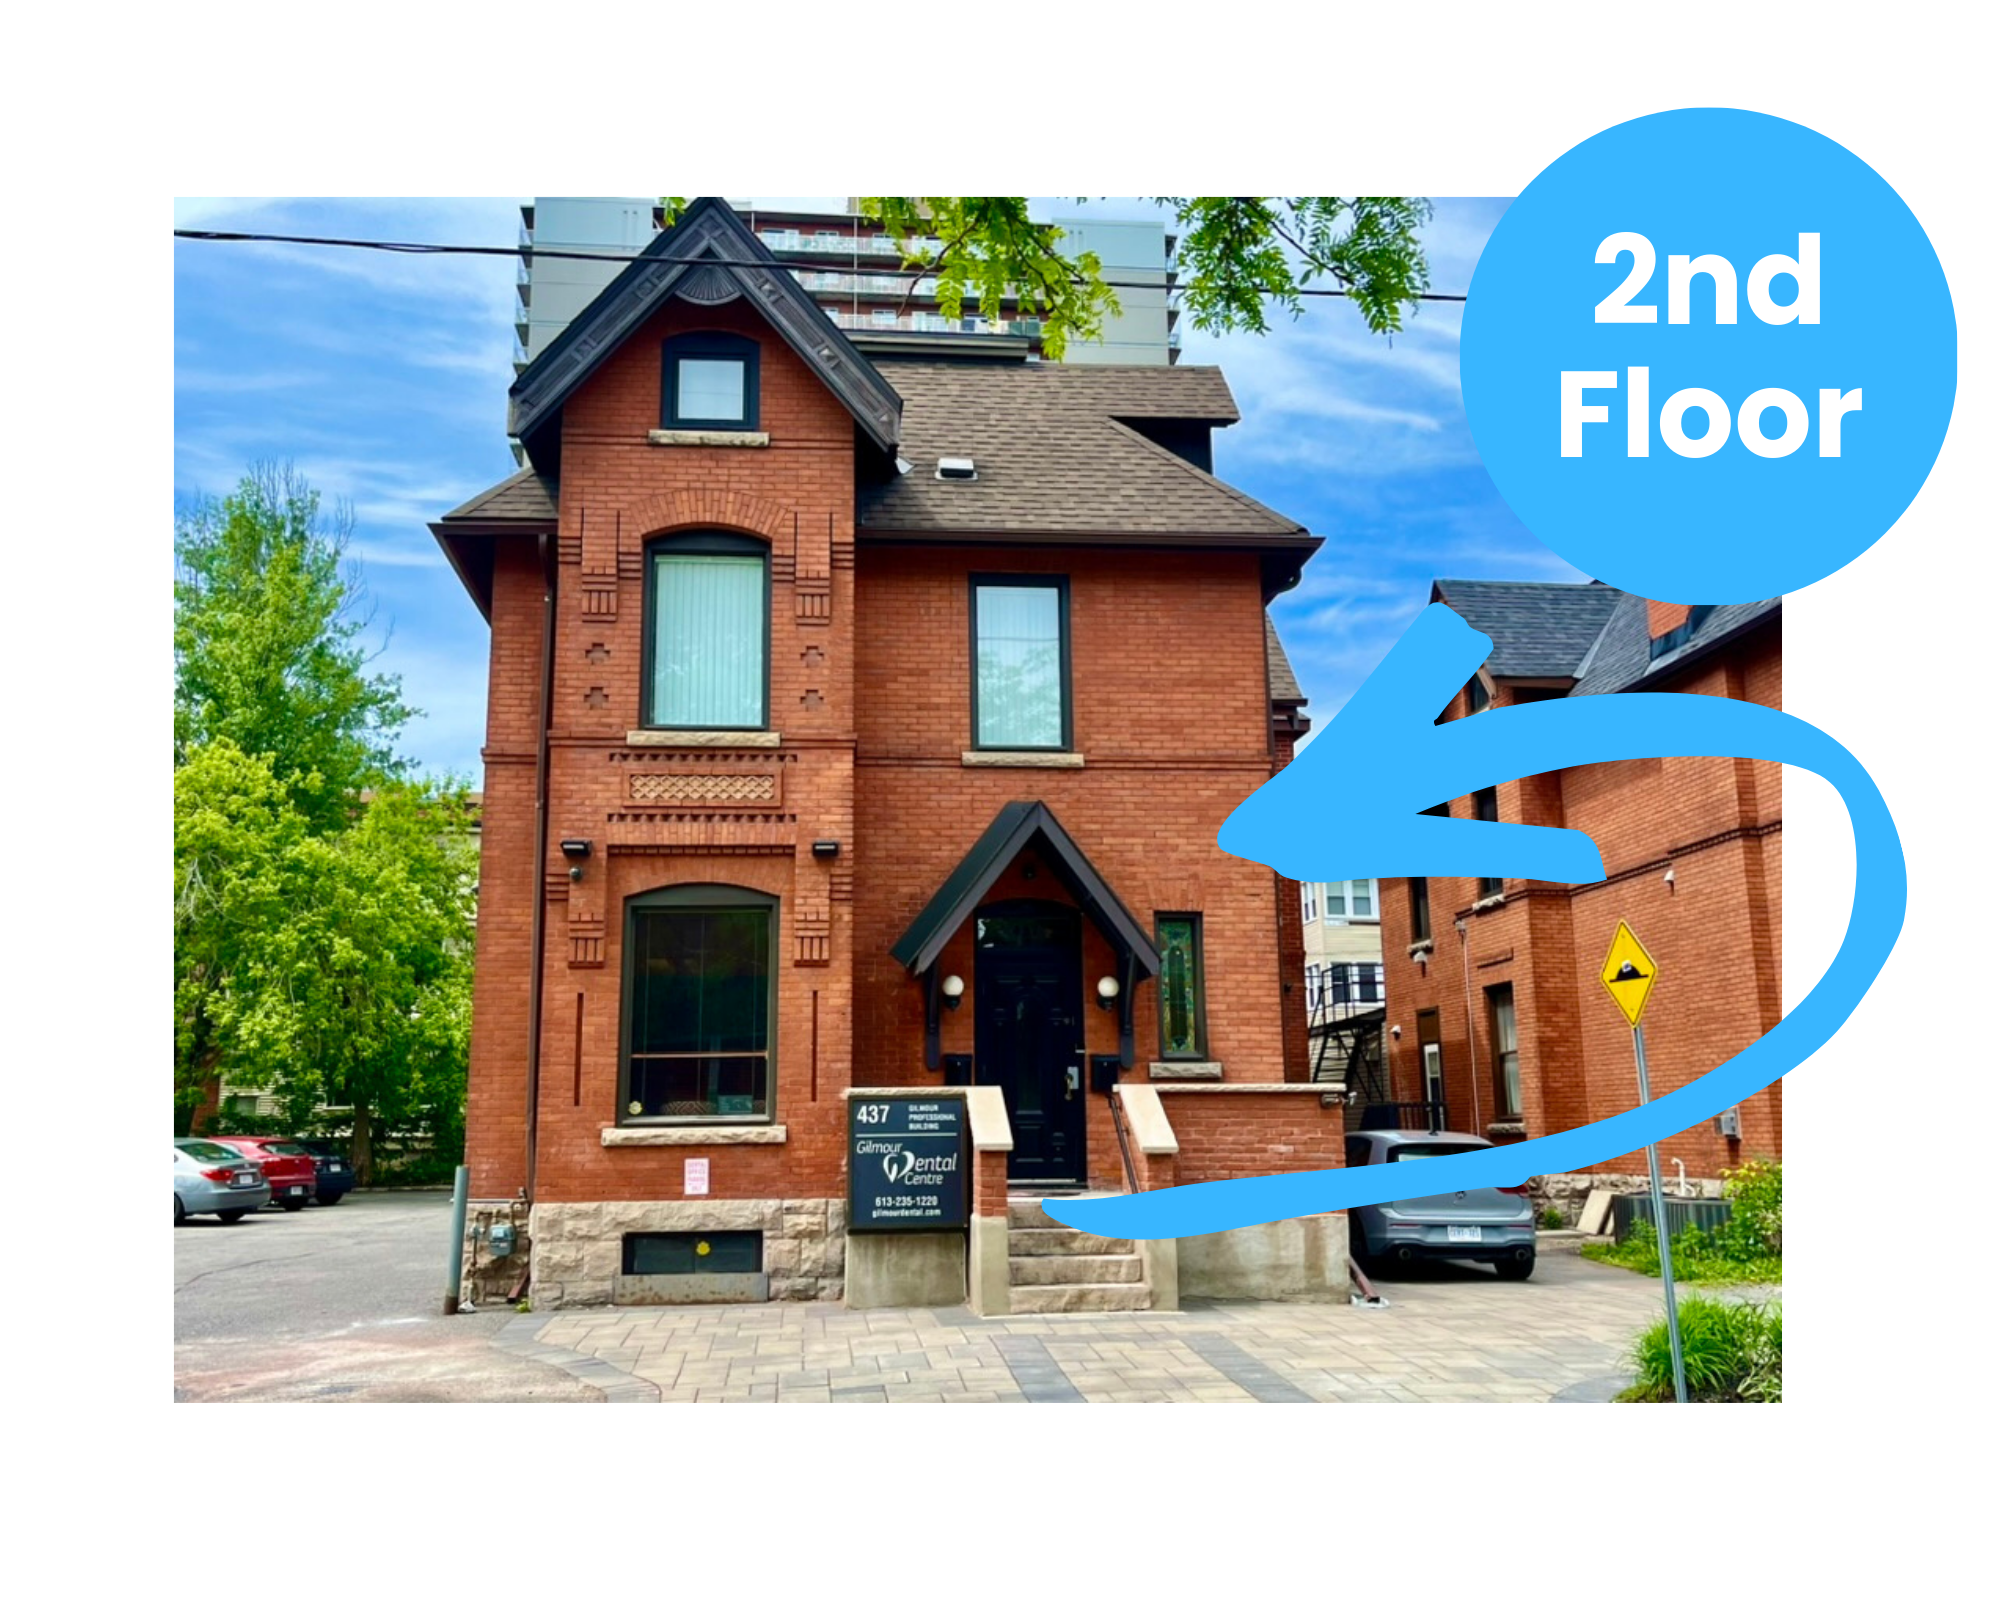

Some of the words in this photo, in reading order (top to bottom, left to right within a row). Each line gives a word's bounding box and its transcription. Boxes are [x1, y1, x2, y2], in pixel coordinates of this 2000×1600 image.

[908, 1104, 938, 1112] GILMOUR
[857, 1105, 890, 1124] 437
[908, 1113, 956, 1121] PROFESSIONAL
[856, 1140, 903, 1155] Gilmour
[904, 1172, 944, 1185] Centre
[872, 1208, 941, 1218] gilmourdental.com
